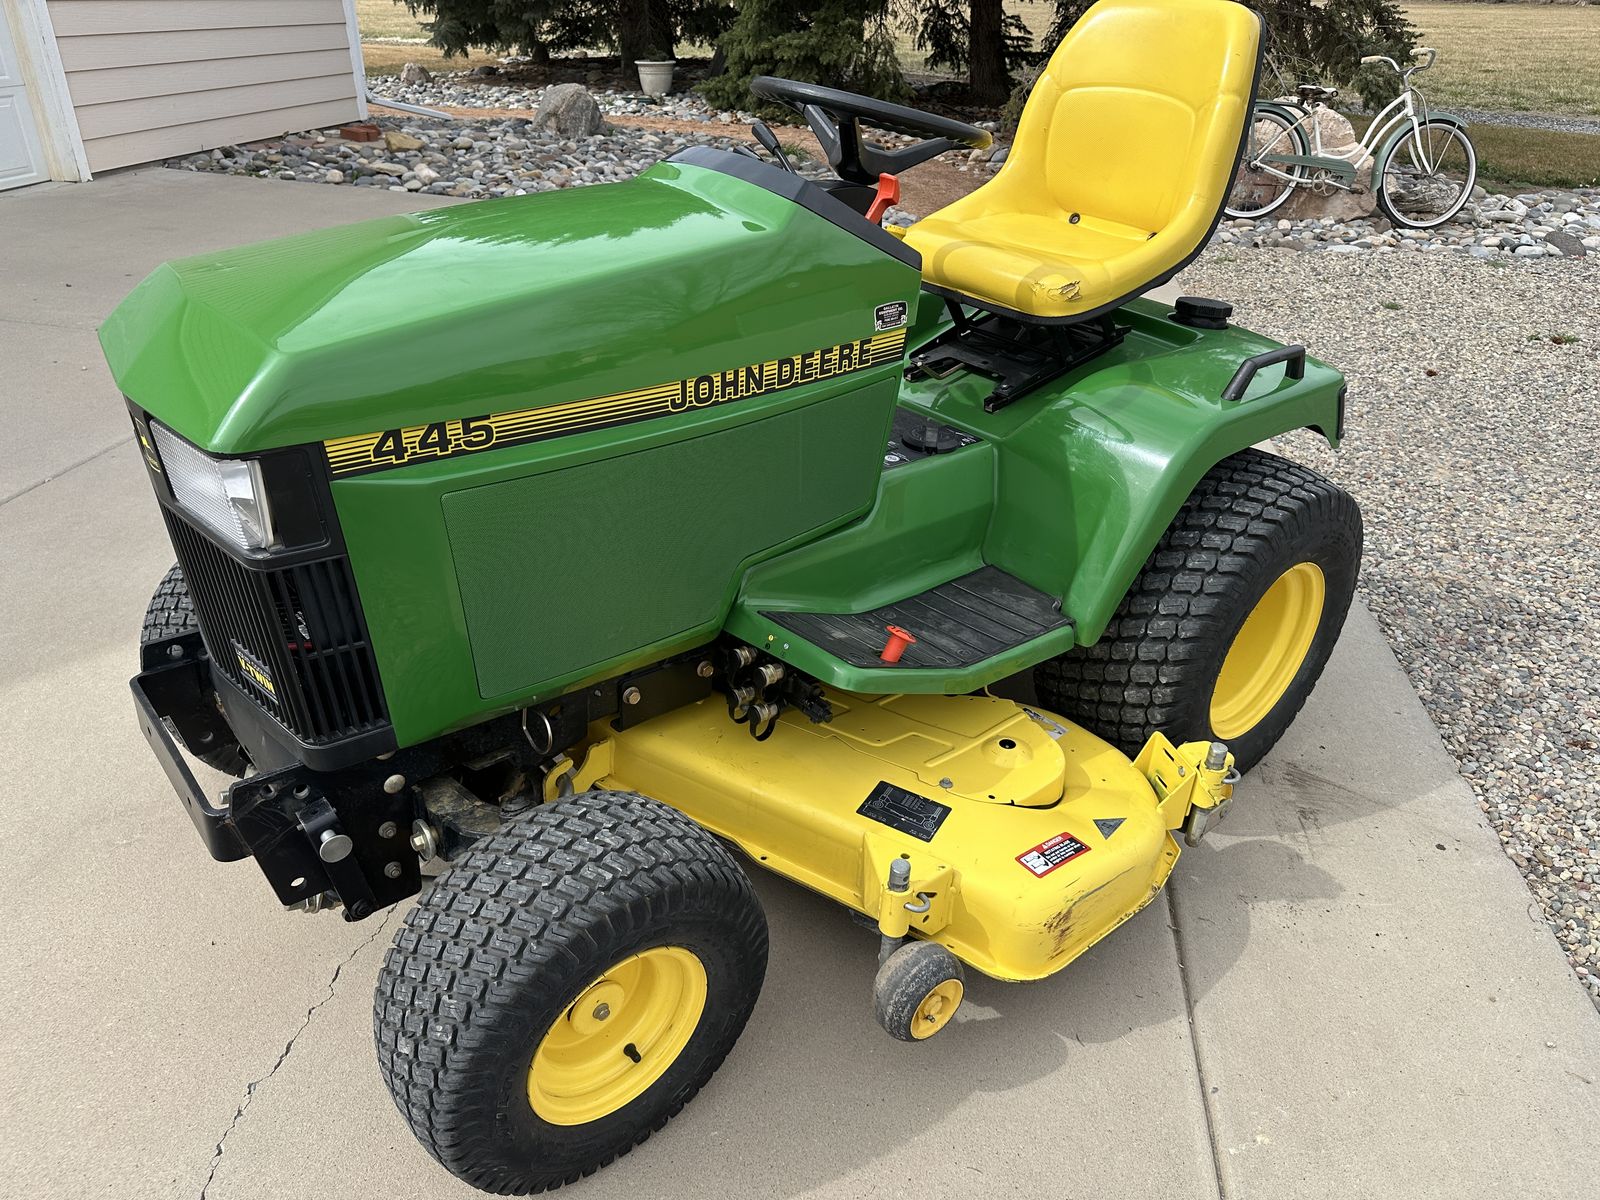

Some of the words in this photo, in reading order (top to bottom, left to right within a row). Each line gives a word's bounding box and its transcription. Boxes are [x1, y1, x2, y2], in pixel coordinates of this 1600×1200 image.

[669, 363, 765, 412] JOHN
[776, 337, 873, 389] DEERE
[371, 414, 495, 464] 445
[237, 655, 275, 694] V-TWIN
[1045, 836, 1063, 846] DANGER
